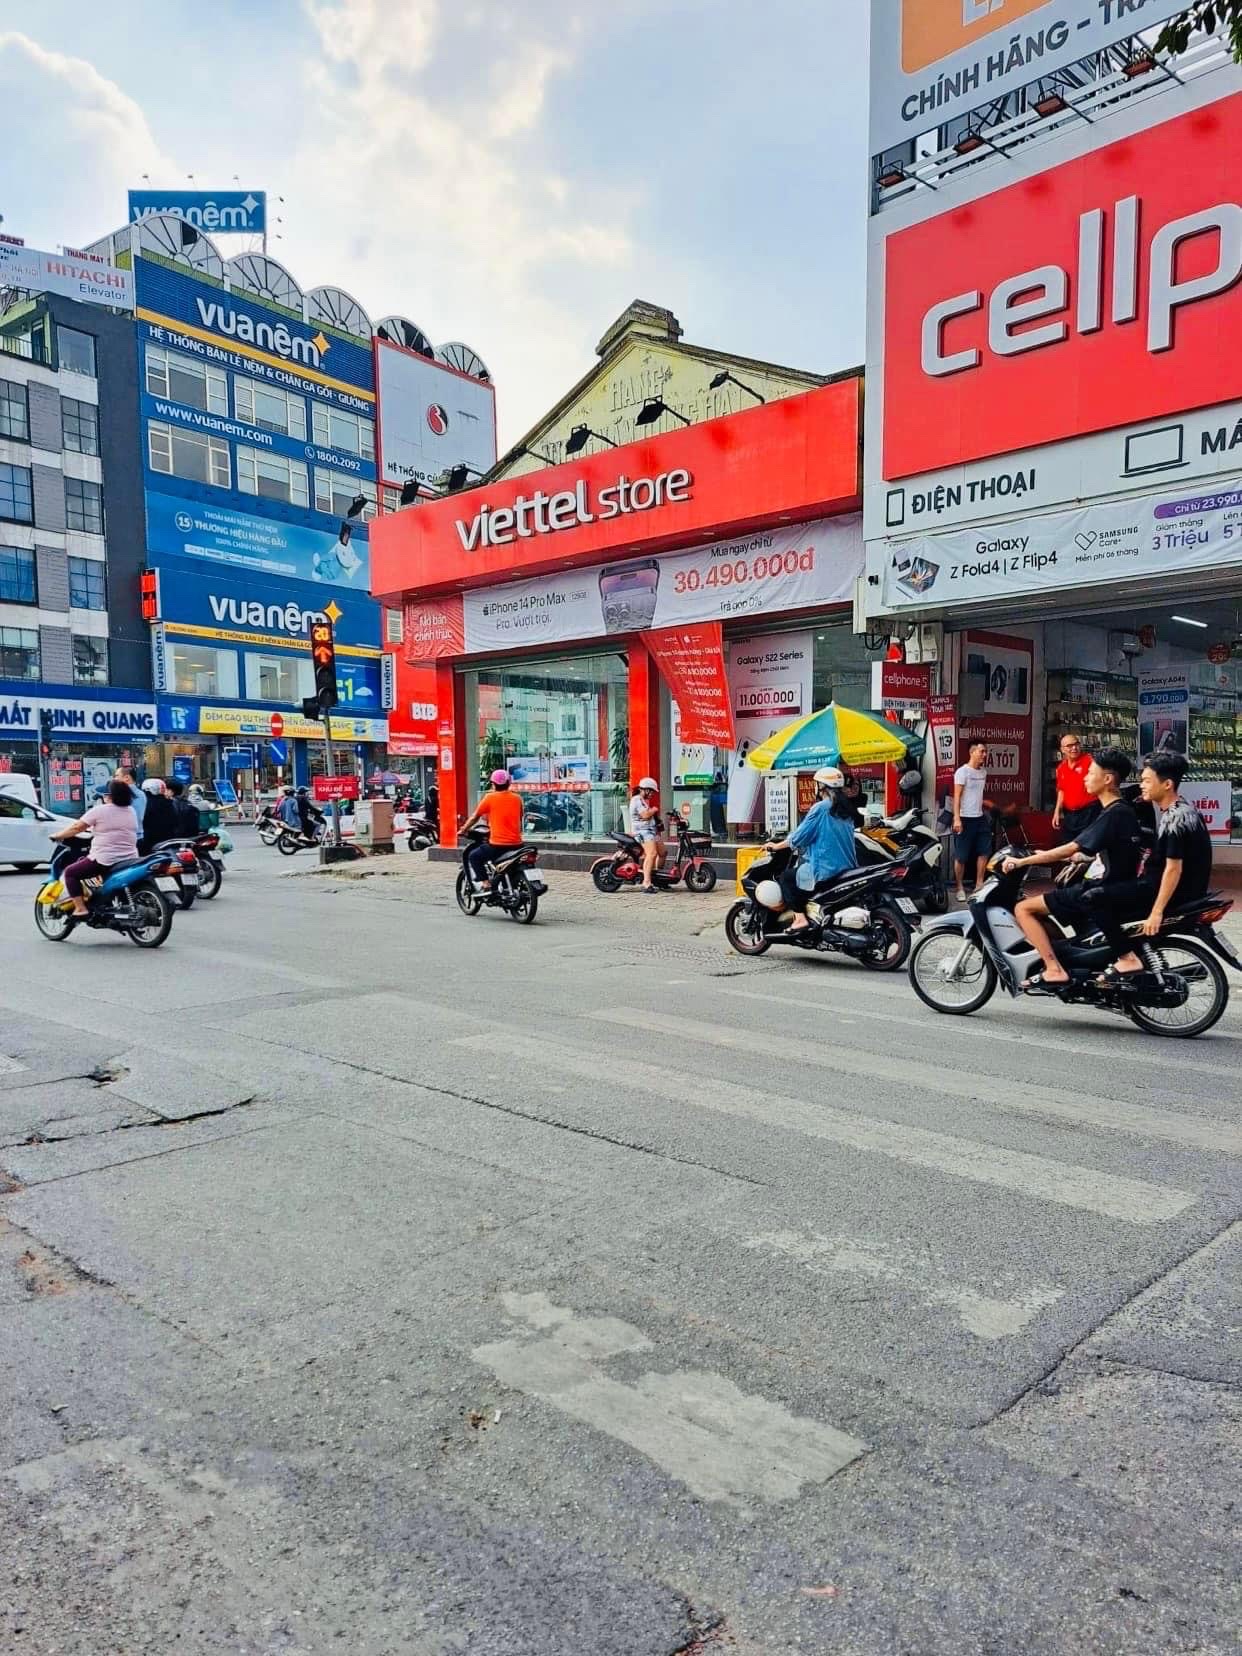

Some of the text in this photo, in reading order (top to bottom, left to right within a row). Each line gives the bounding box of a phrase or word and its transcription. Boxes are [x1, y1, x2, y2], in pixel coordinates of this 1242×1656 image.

[901, 70, 980, 122] CHÍNH
[987, 19, 1069, 82] HÃNG
[46, 261, 126, 289] HITACHI
[80, 283, 127, 301] Elevator
[197, 298, 319, 367] vuanệm
[149, 326, 165, 343] HỆ
[167, 331, 205, 354] THỐNG
[206, 345, 228, 363] BÁN
[266, 368, 274, 379] &
[302, 380, 315, 393] GA
[155, 402, 273, 446] www.vuanem.com
[316, 450, 361, 471] 1800.2092
[911, 469, 1036, 514] ĐIỆN THOẠI
[1202, 494, 1242, 509] 23.990.
[455, 469, 690, 551] viettel store
[179, 517, 190, 527] 15
[1224, 524, 1233, 539] 5
[1099, 526, 1138, 540] SAMSUNG
[1152, 529, 1209, 550] 3 Triệu
[729, 543, 749, 557] ngay
[976, 535, 1029, 554] Galaxy
[674, 546, 815, 594] 30.490.000đ
[950, 566, 958, 579] Z
[962, 560, 1000, 577] Fold4
[1011, 557, 1018, 570] Z
[1023, 551, 1058, 571] Flip4
[489, 601, 518, 615] iPhone
[520, 598, 528, 610] 14
[530, 596, 545, 608] Pro
[546, 592, 566, 605] Max
[737, 651, 804, 666] Galaxy S22 Series
[740, 690, 794, 706] 11.000.000
[93, 711, 153, 730] QUANG
[996, 748, 1014, 768] TỐT
